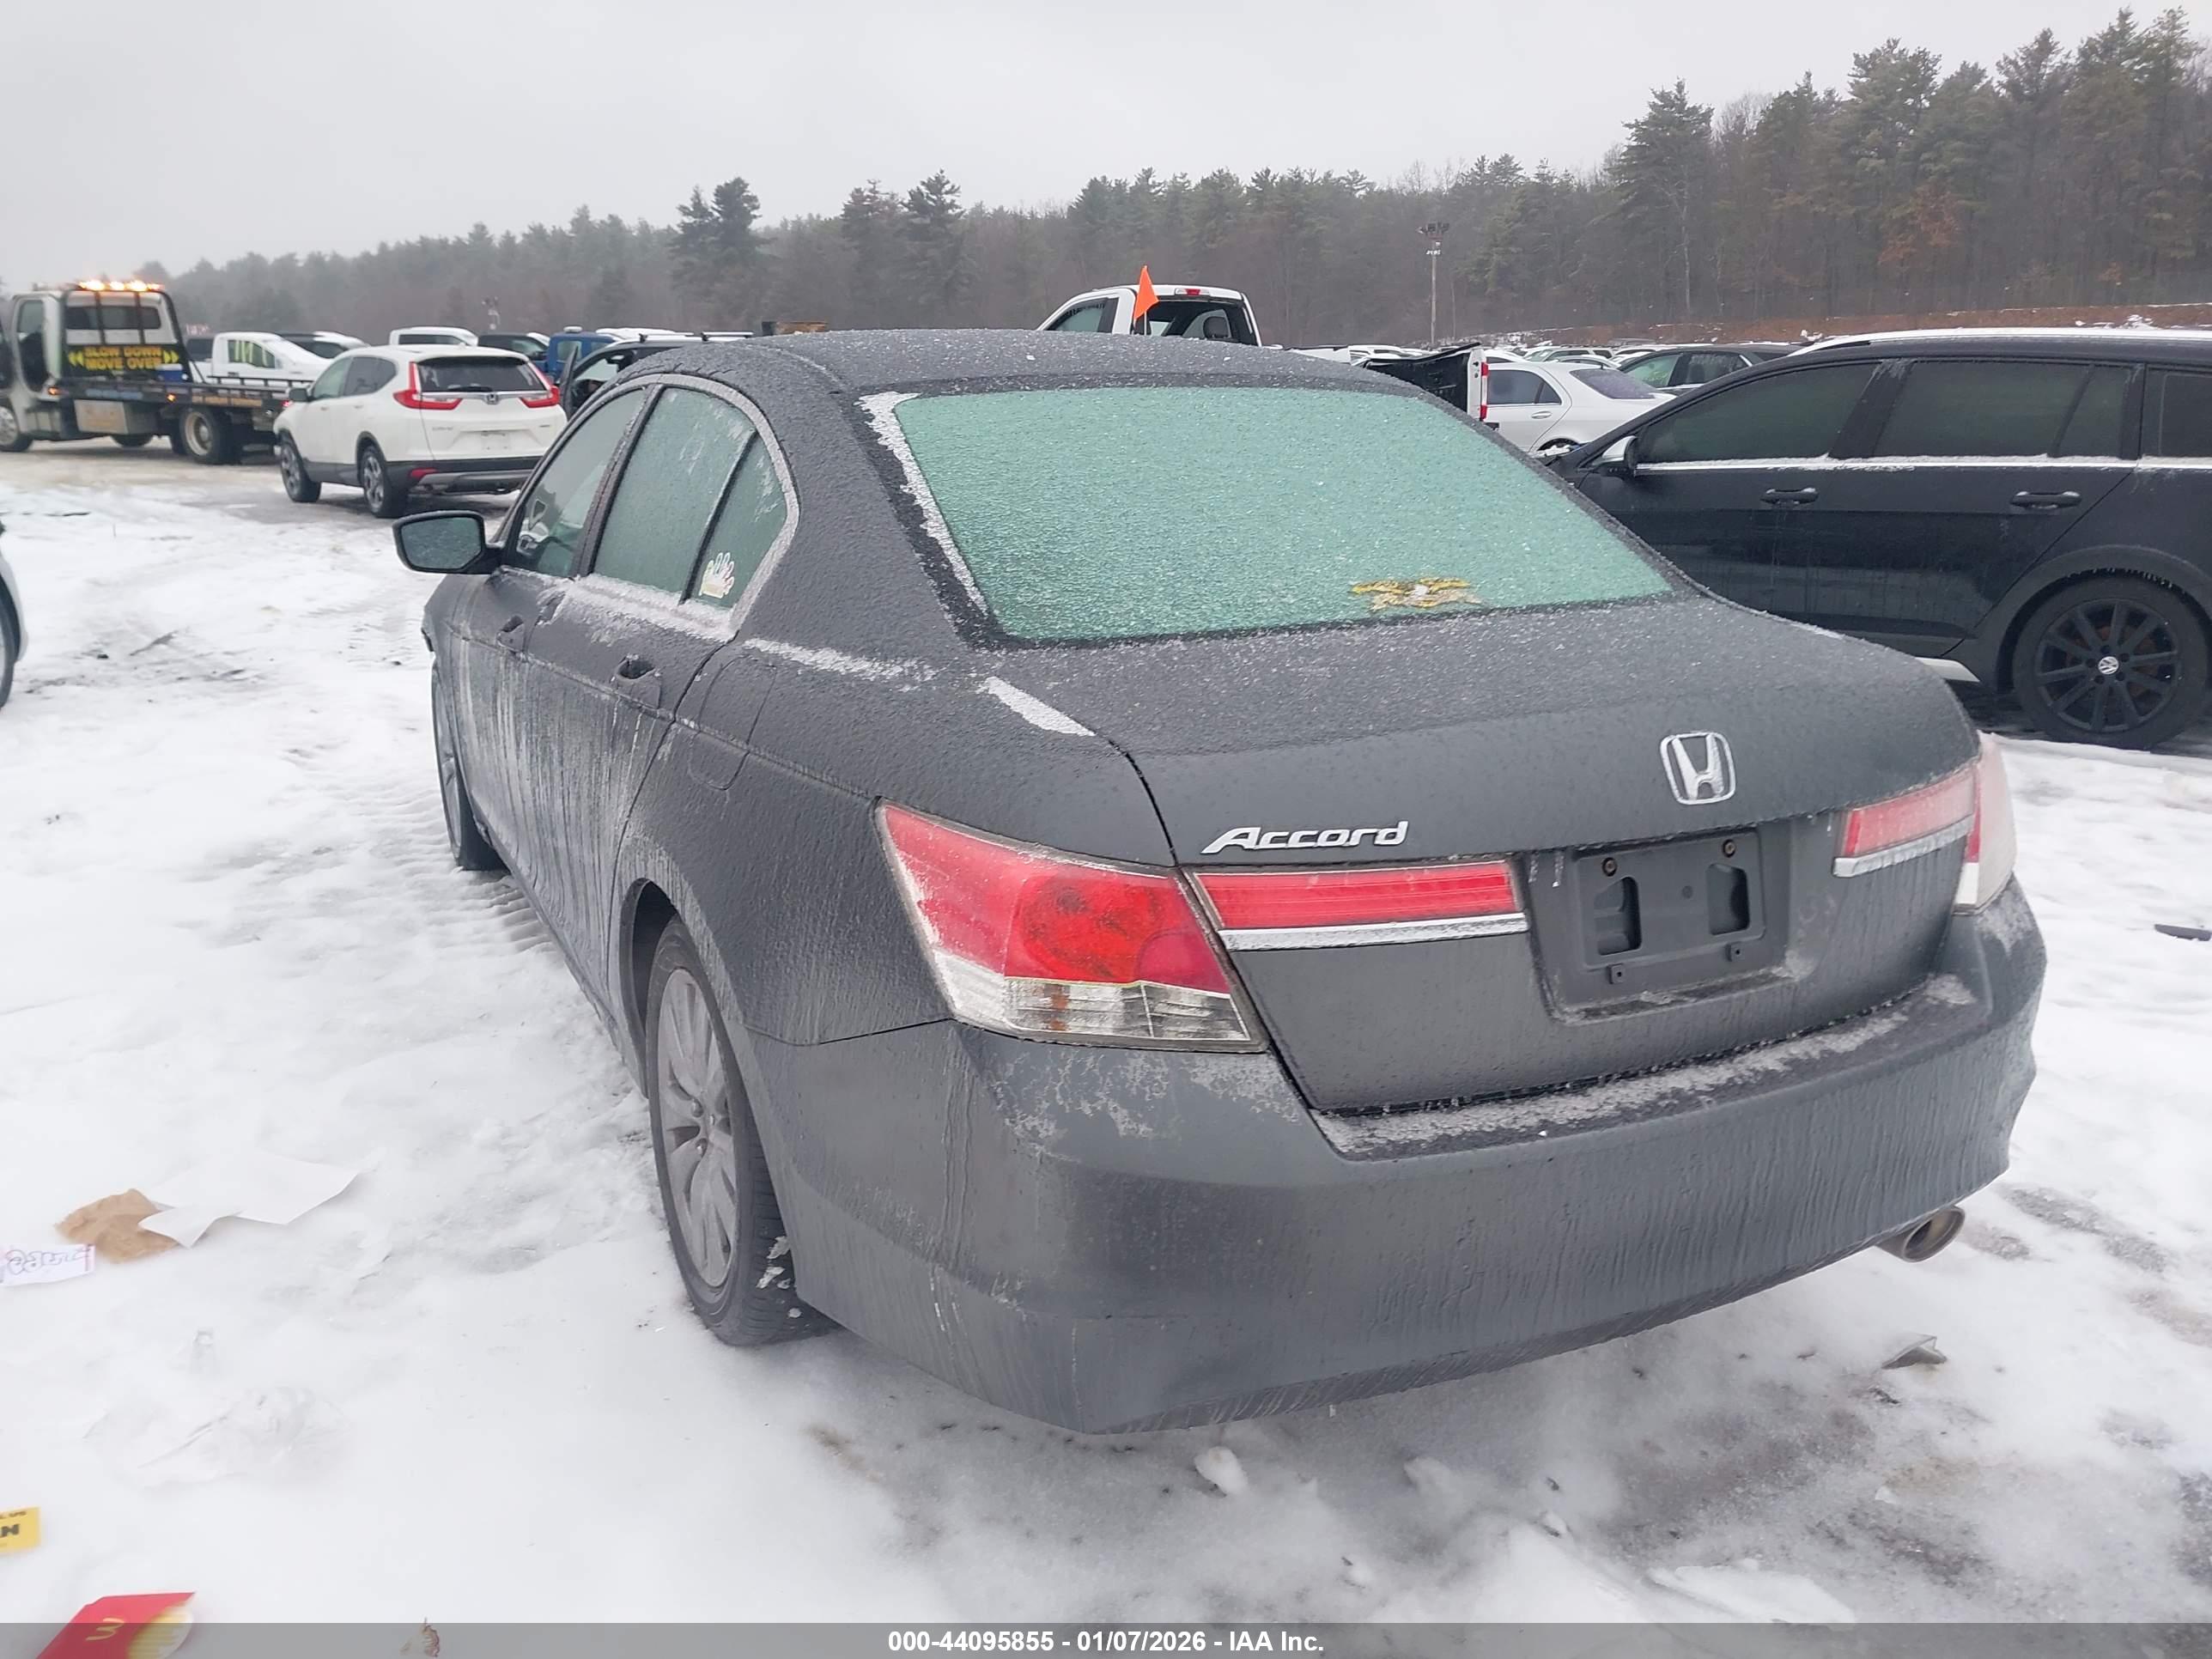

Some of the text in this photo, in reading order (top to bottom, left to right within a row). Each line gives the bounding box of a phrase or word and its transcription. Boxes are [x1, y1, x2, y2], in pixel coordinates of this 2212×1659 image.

[83, 346, 162, 357] SLOW DOWN
[85, 357, 162, 370] MOVE OVER
[1200, 820, 1410, 855] Accord
